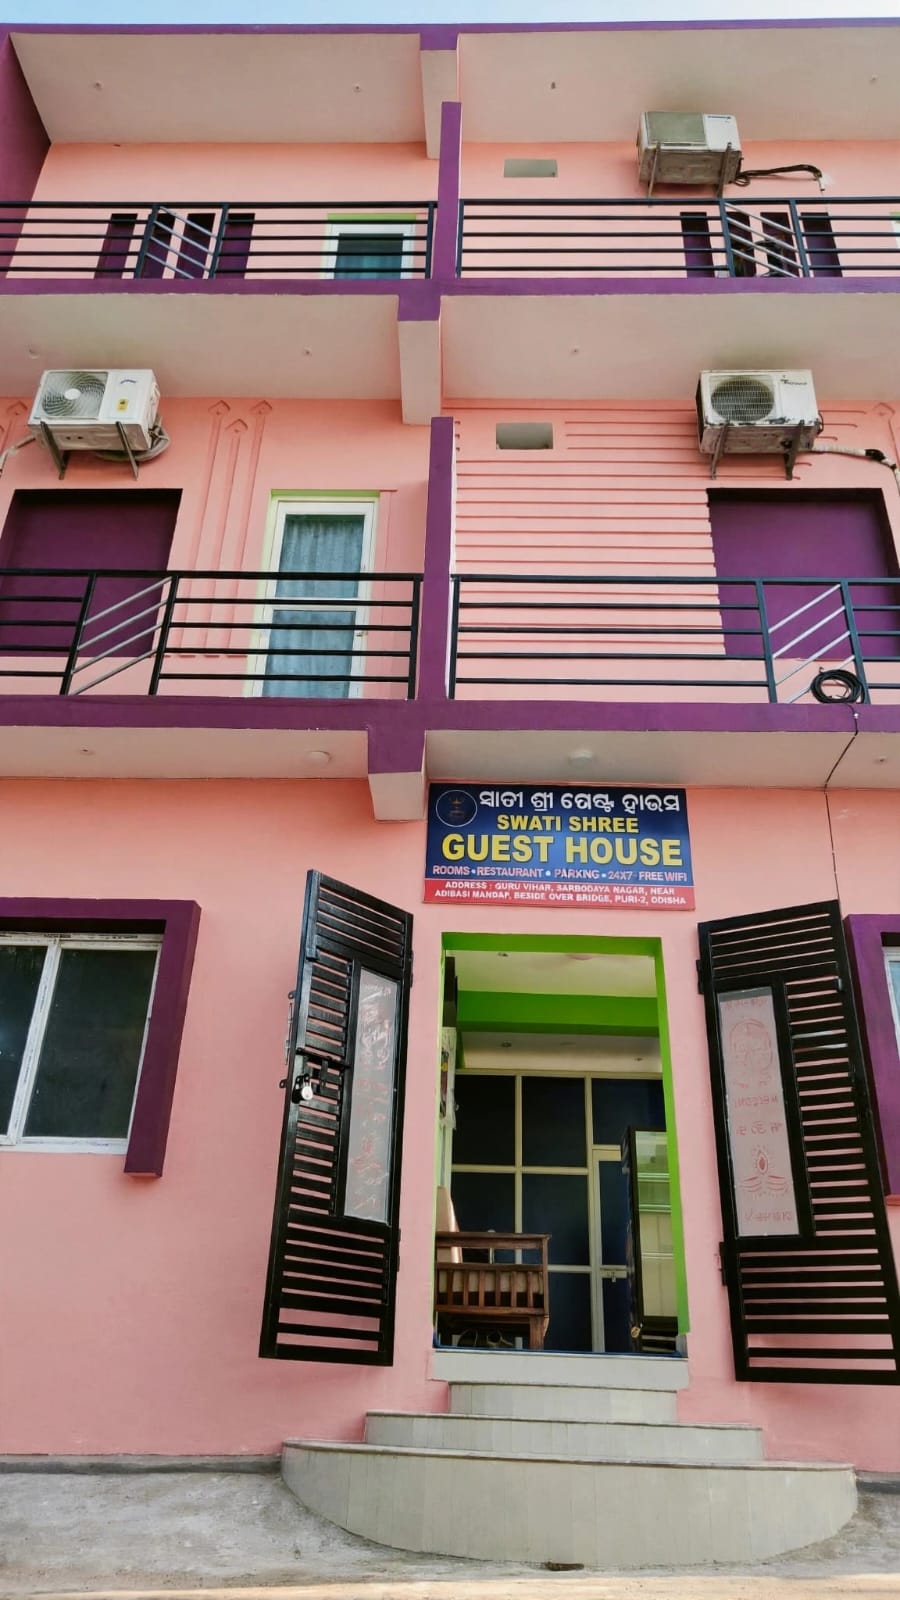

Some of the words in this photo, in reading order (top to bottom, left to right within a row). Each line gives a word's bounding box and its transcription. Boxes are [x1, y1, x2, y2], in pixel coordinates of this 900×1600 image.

[497, 814, 561, 832] SWATI
[569, 816, 640, 833] SHREE
[441, 833, 554, 862] GUEST
[566, 837, 683, 866] HOUSE
[432, 865, 470, 875] ROOMS
[476, 866, 544, 877] RESTAURANT
[638, 871, 663, 881] FREE
[663, 872, 688, 882] WIFI
[445, 881, 487, 889] ADDRESS
[556, 884, 611, 893] SARBODAYA
[613, 886, 648, 895] NAGAR,
[650, 887, 675, 895] NEAR
[435, 889, 470, 897] ADIBASI
[514, 892, 545, 900] BESIDE
[548, 893, 574, 901] OVER
[651, 896, 687, 905] ODISHA
